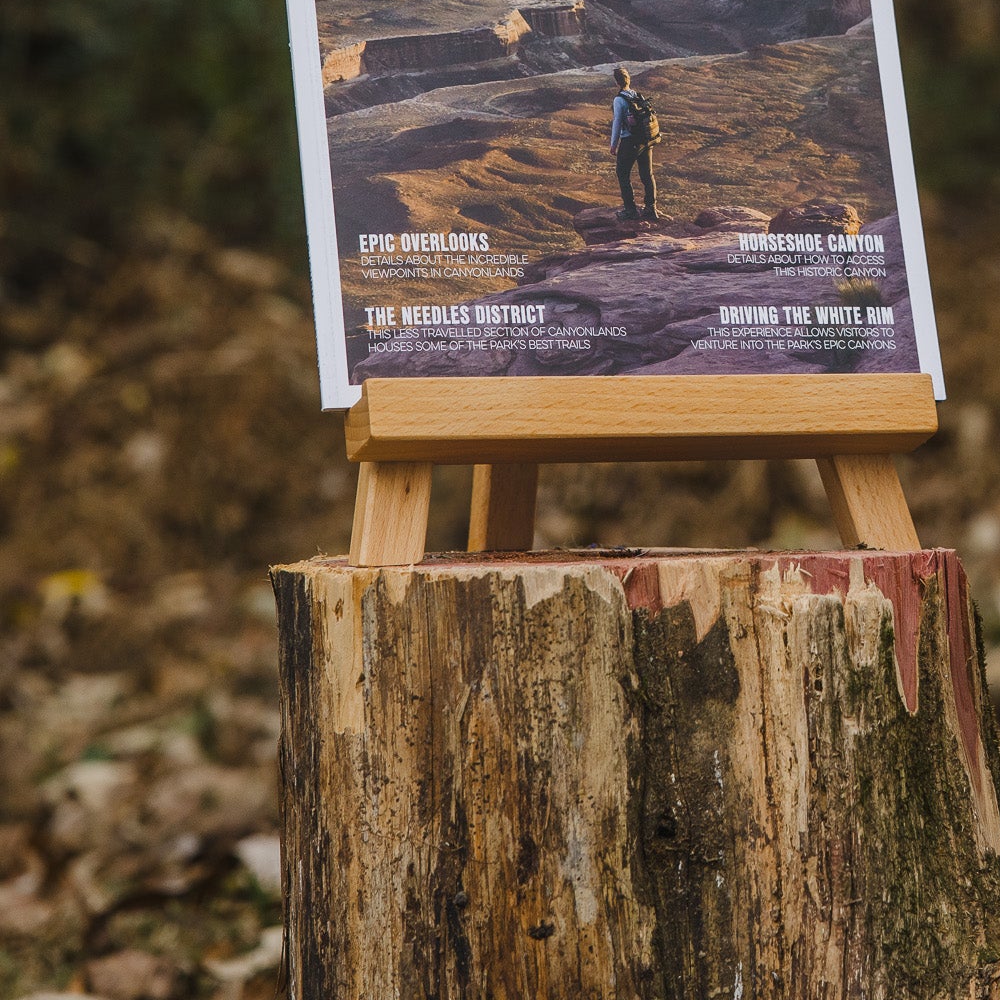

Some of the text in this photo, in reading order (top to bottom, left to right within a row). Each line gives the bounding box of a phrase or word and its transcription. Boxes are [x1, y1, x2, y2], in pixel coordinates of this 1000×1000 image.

[359, 233, 489, 252] EPIC OVERLOOKS
[739, 234, 884, 252] HORSESHOE CANYON
[361, 255, 528, 265] DETAILS ABOUT THE INCREDIBLE
[728, 254, 884, 265] DETAILS ABOUT HOW TO ACCESS
[362, 268, 524, 278] VIEWPOINTS IN CANYONLANDS
[773, 267, 886, 277] THIS HISTORIC CANYON
[365, 305, 545, 326] THE NEEDLES DISTRICT
[720, 306, 894, 324] DRIVING THE WHITE RIM
[367, 327, 626, 339] THIS LESS TRAVELLED SECTION OF CANYONLANDS
[707, 327, 894, 337] THIS EXPERIENCE ALLOWS VISITORS TO
[369, 342, 413, 352] HOUSES
[415, 341, 447, 351] SOME
[449, 341, 464, 350] OF
[465, 340, 487, 350] THE
[529, 340, 555, 350] BEST
[555, 339, 591, 349] TRAILS
[691, 340, 737, 349] VENTURE
[741, 340, 763, 349] INTO
[765, 340, 785, 349] THE
[824, 340, 846, 349] EPIC
[848, 340, 896, 349] CANYONS
